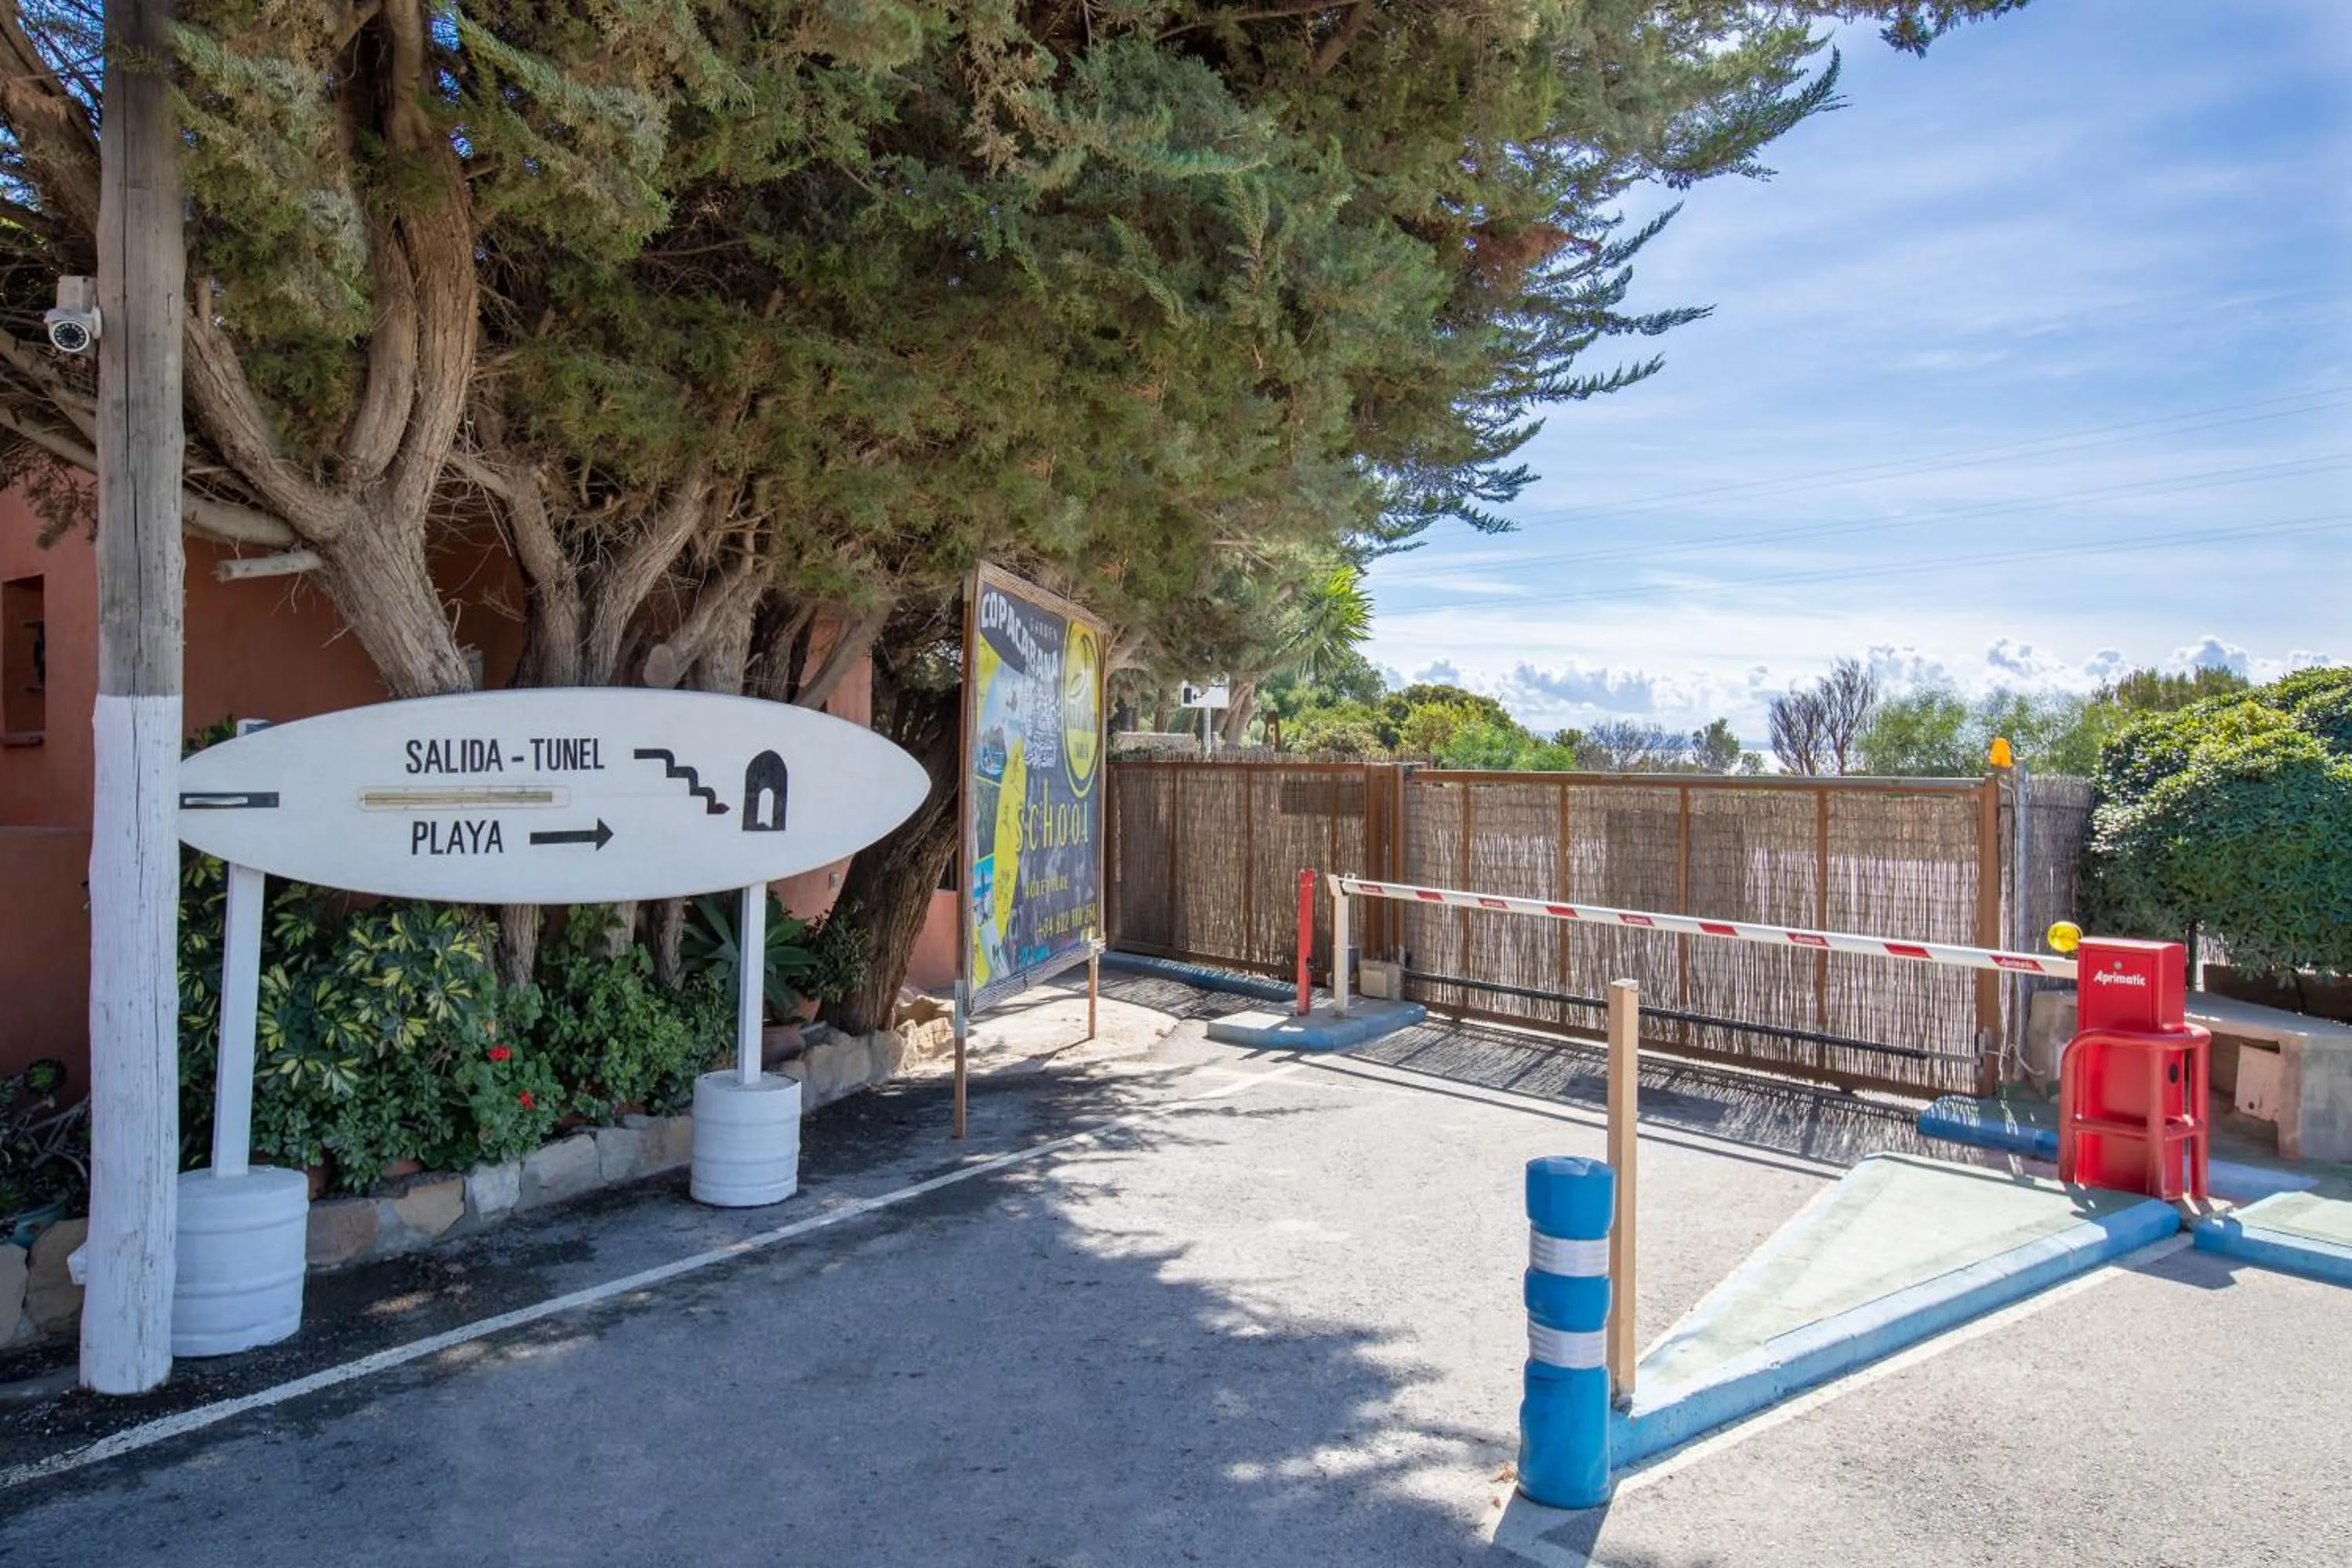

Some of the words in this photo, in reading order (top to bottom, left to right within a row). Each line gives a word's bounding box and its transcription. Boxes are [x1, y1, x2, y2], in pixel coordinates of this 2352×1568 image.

[981, 592, 1059, 684] COPACABANA
[405, 739, 503, 775] SALIDA
[529, 738, 605, 771] TUNEL
[411, 819, 504, 855] PLAYA
[2093, 970, 2146, 986] Aprimatic
